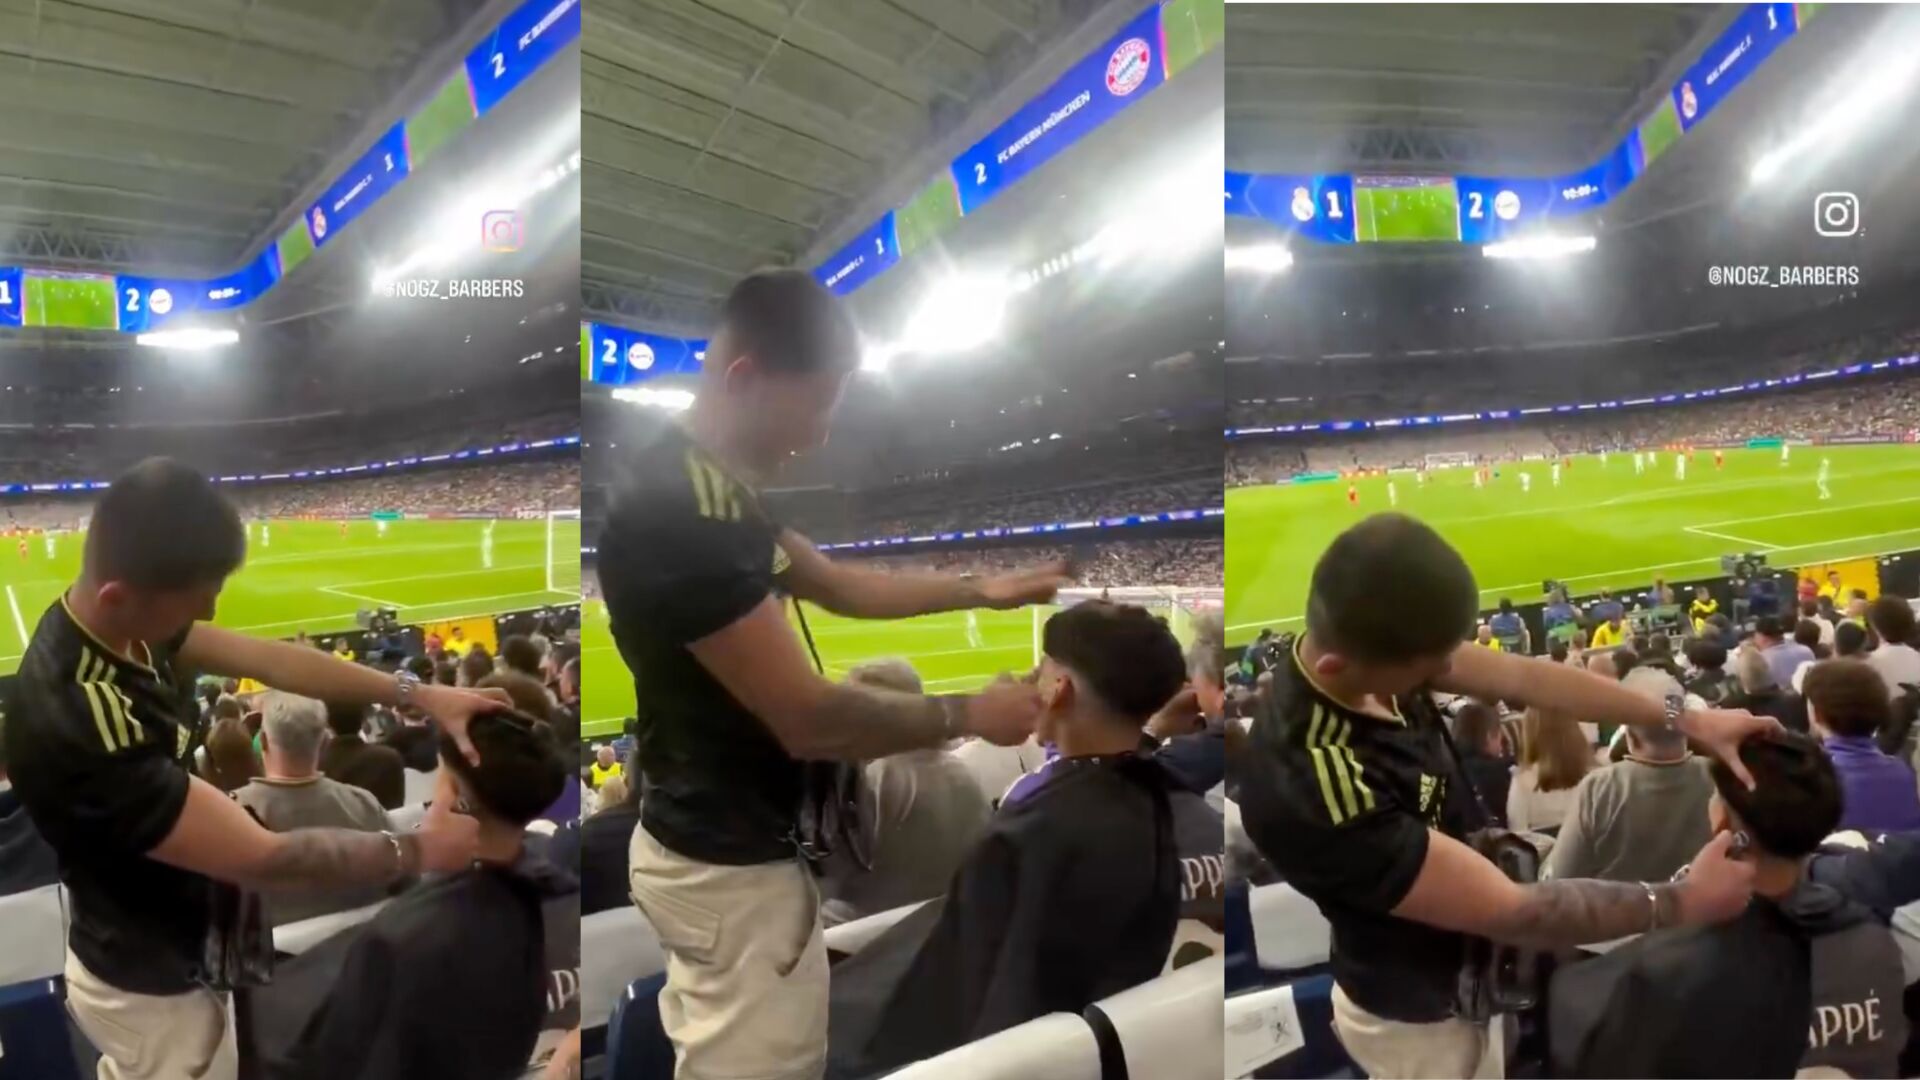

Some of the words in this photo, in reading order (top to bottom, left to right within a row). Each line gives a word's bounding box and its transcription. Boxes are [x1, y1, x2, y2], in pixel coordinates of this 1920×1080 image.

[491, 52, 506, 79] 2
[997, 148, 1009, 164] FC
[1008, 125, 1042, 157] BAYERN
[1042, 90, 1090, 132] MÜNCHEN
[974, 163, 988, 185] 2
[1327, 191, 1344, 218] 1
[1469, 192, 1483, 218] 2
[875, 237, 885, 255] 1
[0, 280, 12, 304] 1
[126, 288, 140, 312] 2
[602, 338, 617, 364] 2
